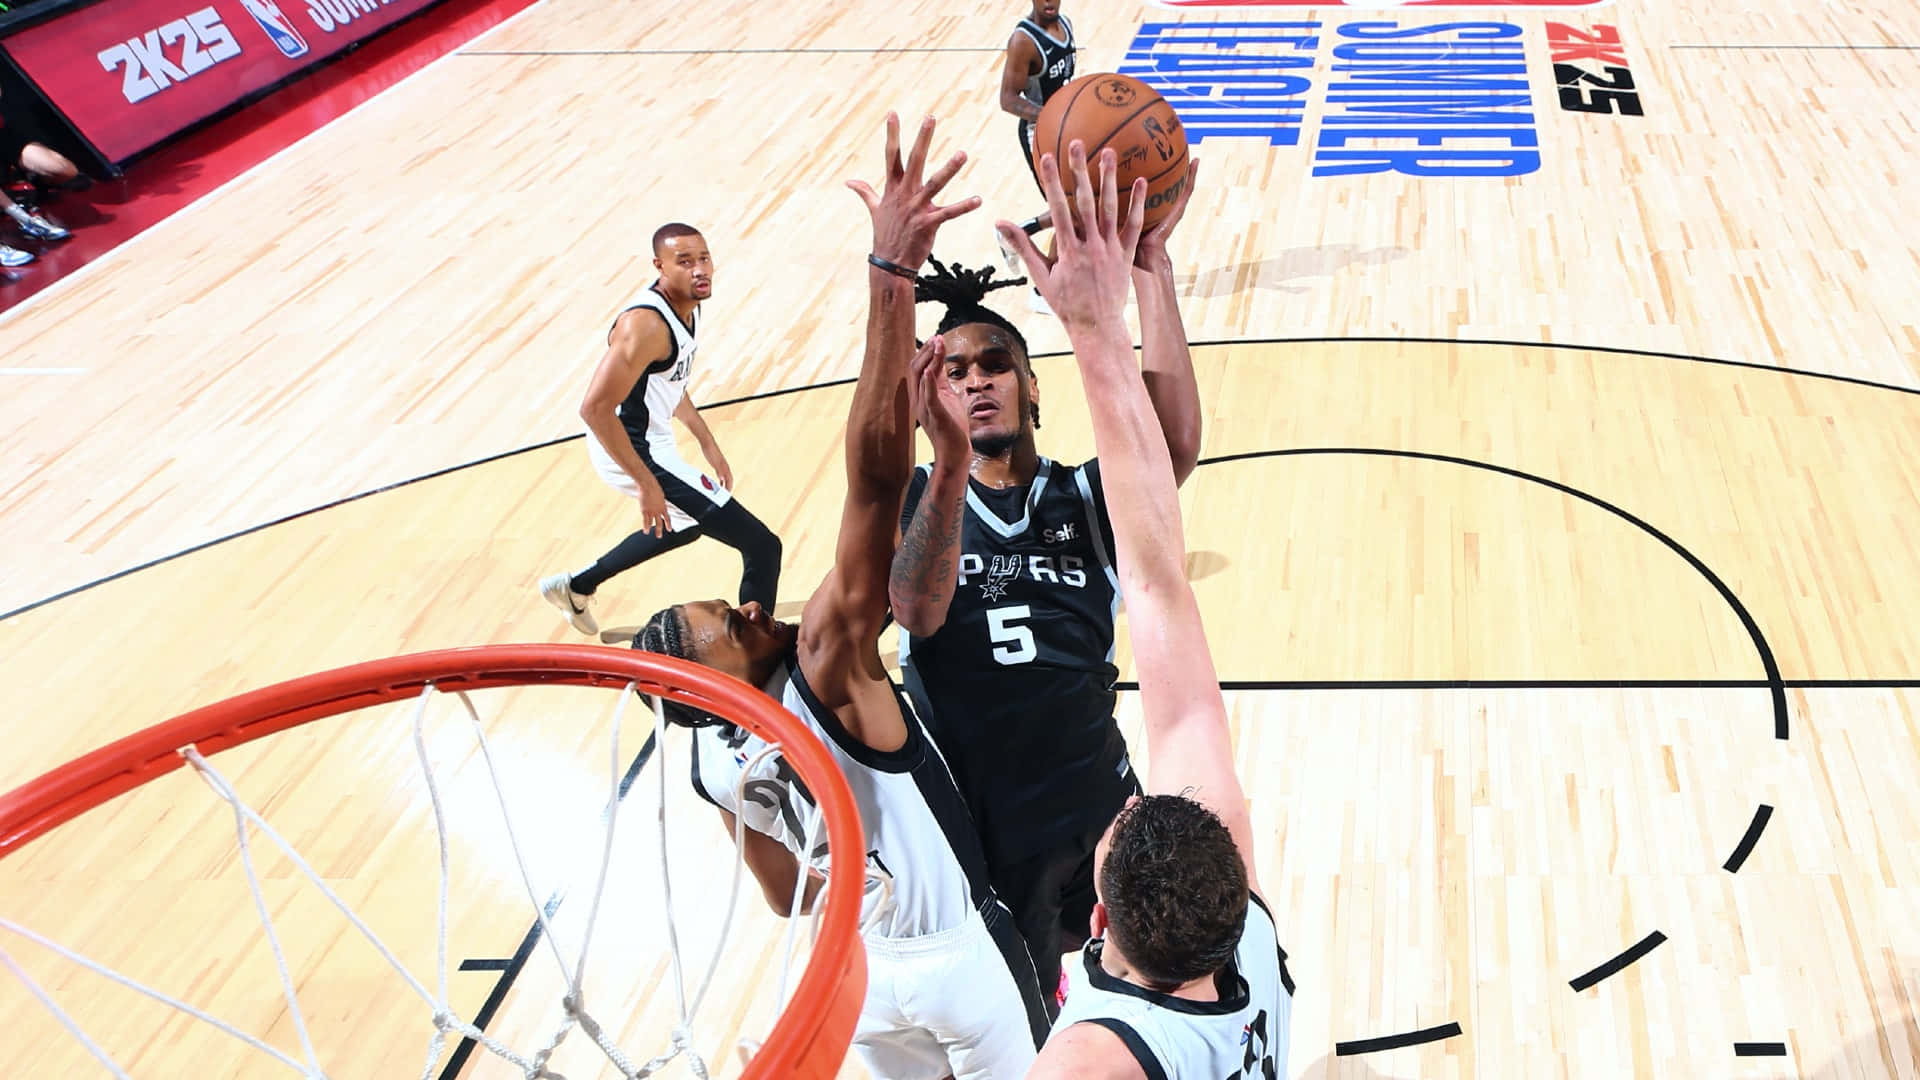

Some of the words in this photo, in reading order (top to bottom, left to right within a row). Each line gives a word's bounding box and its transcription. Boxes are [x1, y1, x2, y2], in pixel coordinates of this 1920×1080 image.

[97, 6, 242, 104] 2K25
[1312, 21, 1542, 177] SUMMER
[1545, 21, 1645, 117] 2K25
[958, 553, 1087, 601] PURS
[986, 604, 1037, 666] 5
